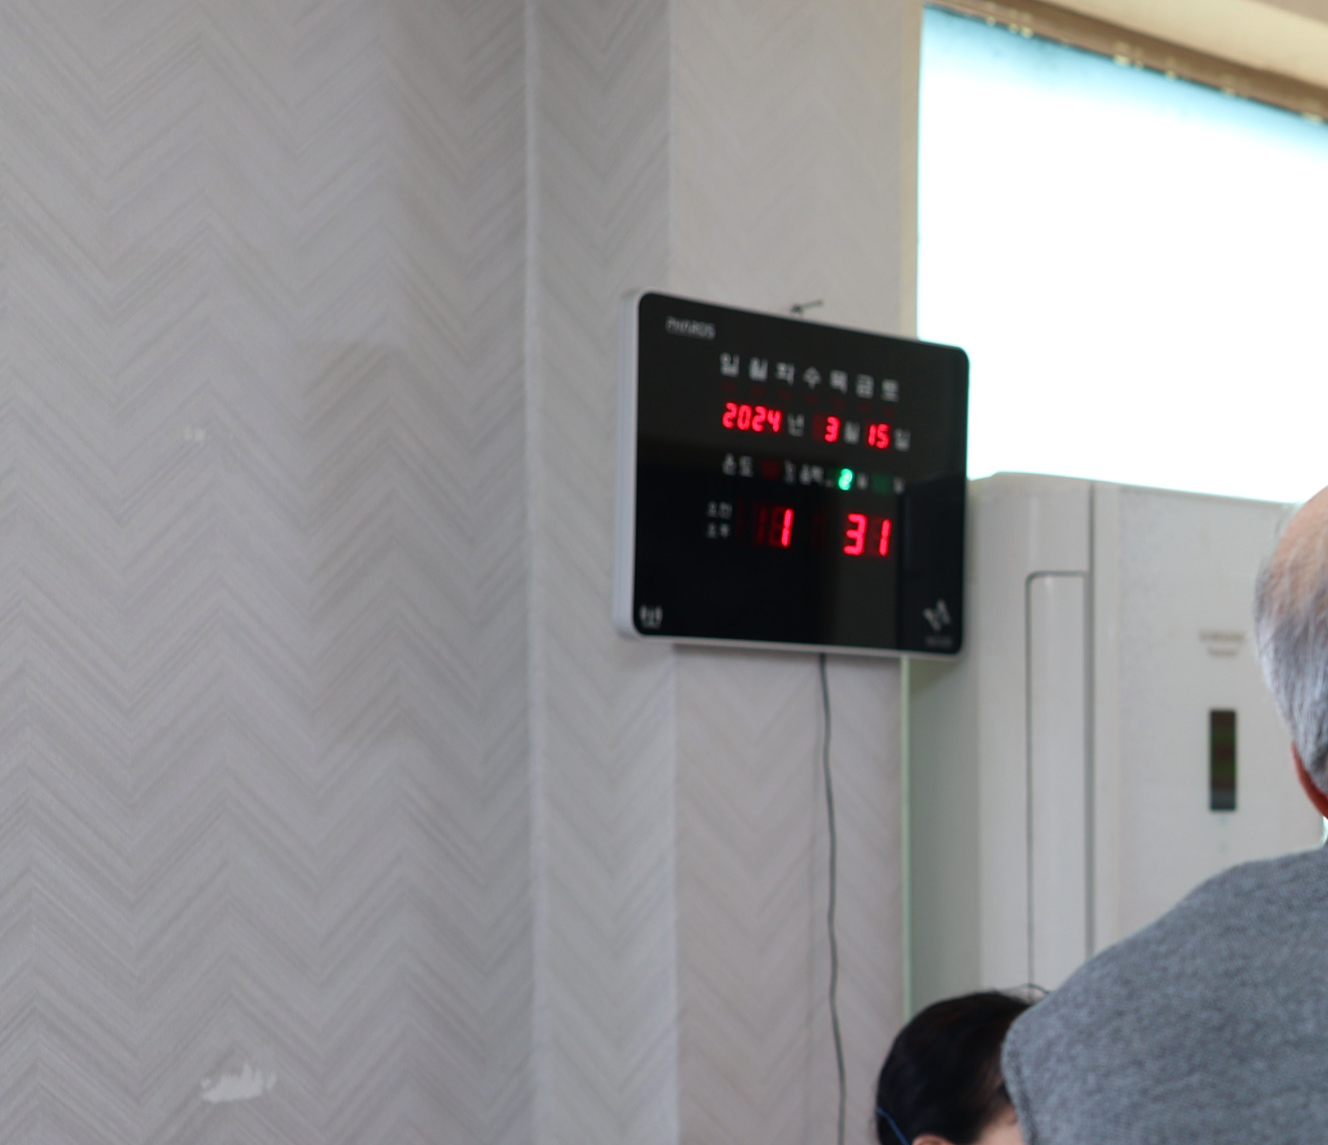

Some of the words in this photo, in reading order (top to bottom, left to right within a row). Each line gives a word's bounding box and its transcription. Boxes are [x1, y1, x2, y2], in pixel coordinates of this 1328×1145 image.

[803, 366, 822, 390] 수
[722, 402, 782, 433] 2024
[824, 416, 840, 443] 3
[867, 423, 890, 449] 15
[781, 508, 794, 547] 1
[843, 513, 892, 556] 31
